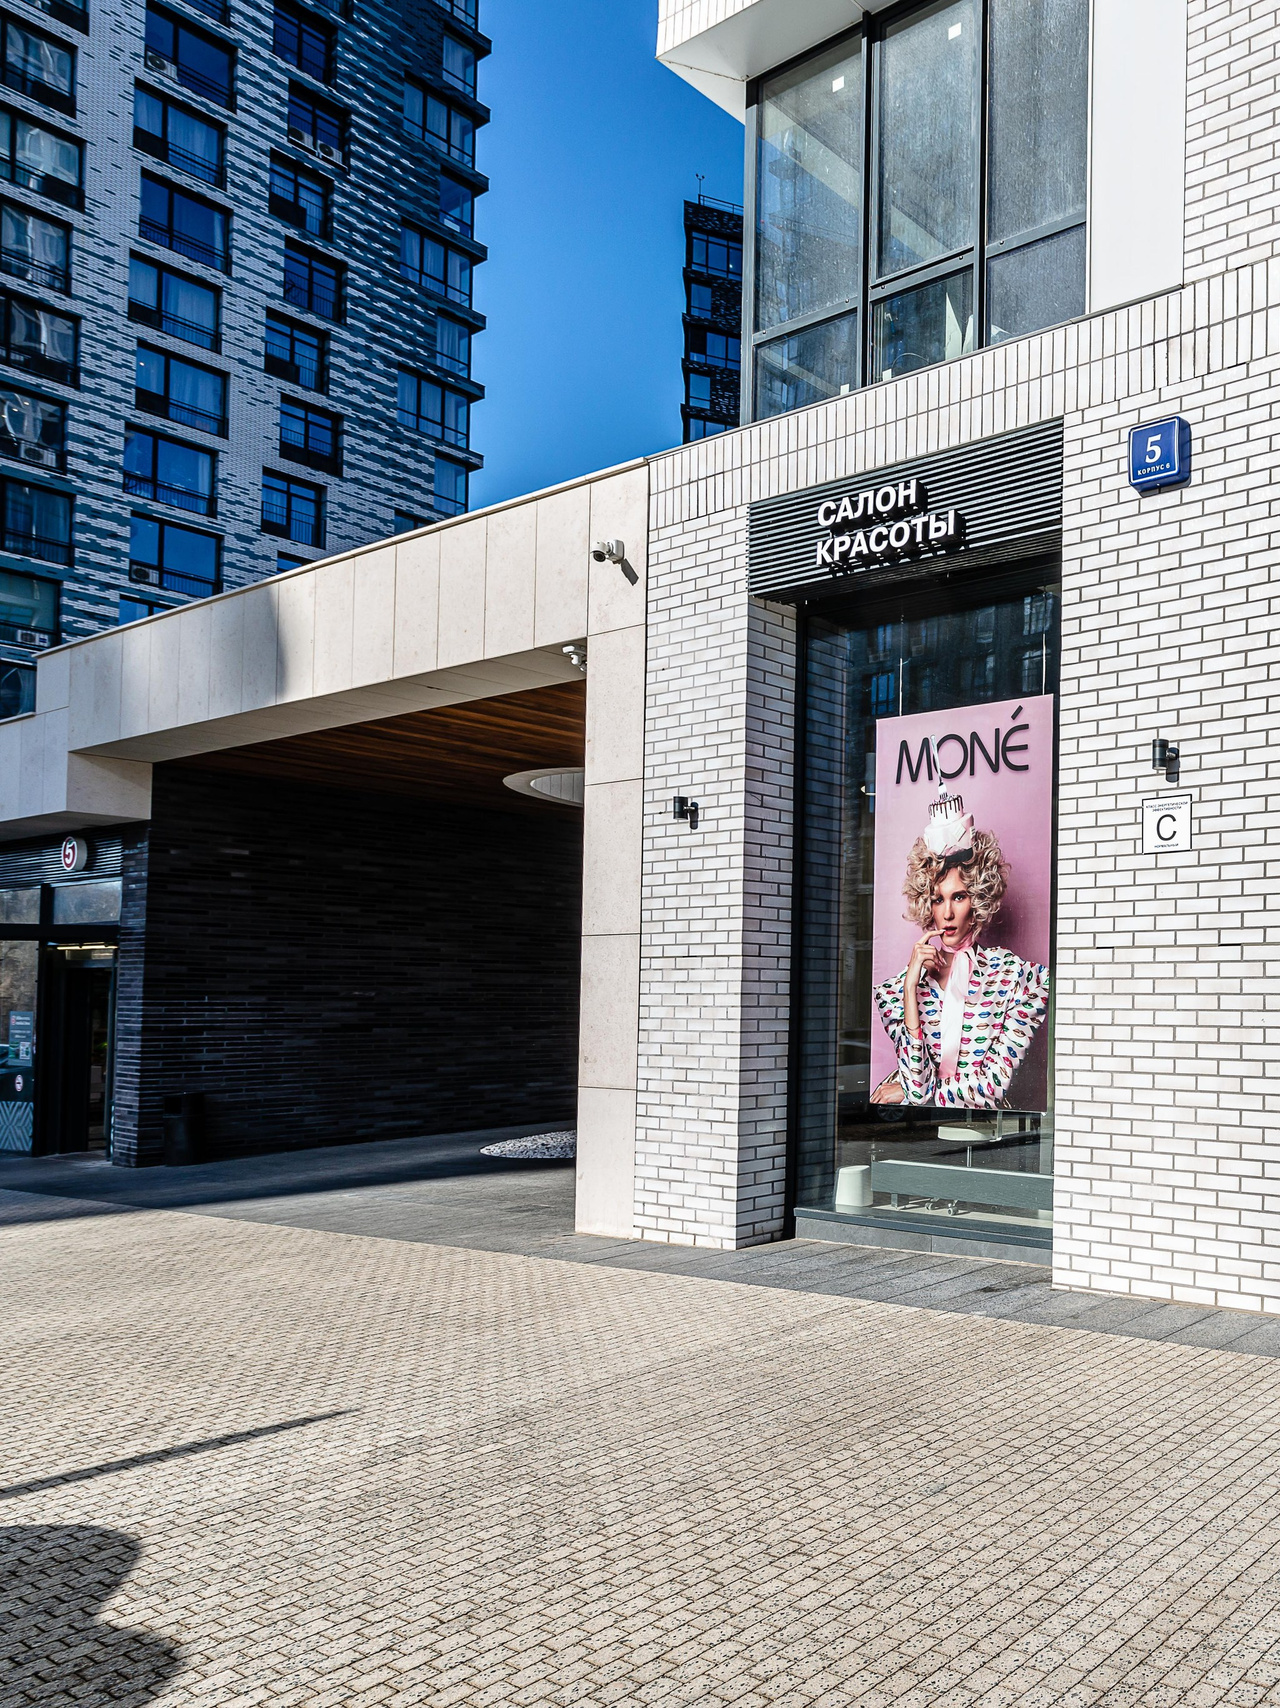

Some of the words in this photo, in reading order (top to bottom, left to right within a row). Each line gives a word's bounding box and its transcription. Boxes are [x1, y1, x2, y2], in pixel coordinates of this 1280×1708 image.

[1145, 433, 1162, 464] 5
[1137, 464, 1165, 476] КОРПУС
[817, 479, 917, 527] САЛОН
[816, 509, 955, 566] КРАСОТЫ
[896, 705, 1030, 784] MONÉ
[1156, 814, 1177, 841] C
